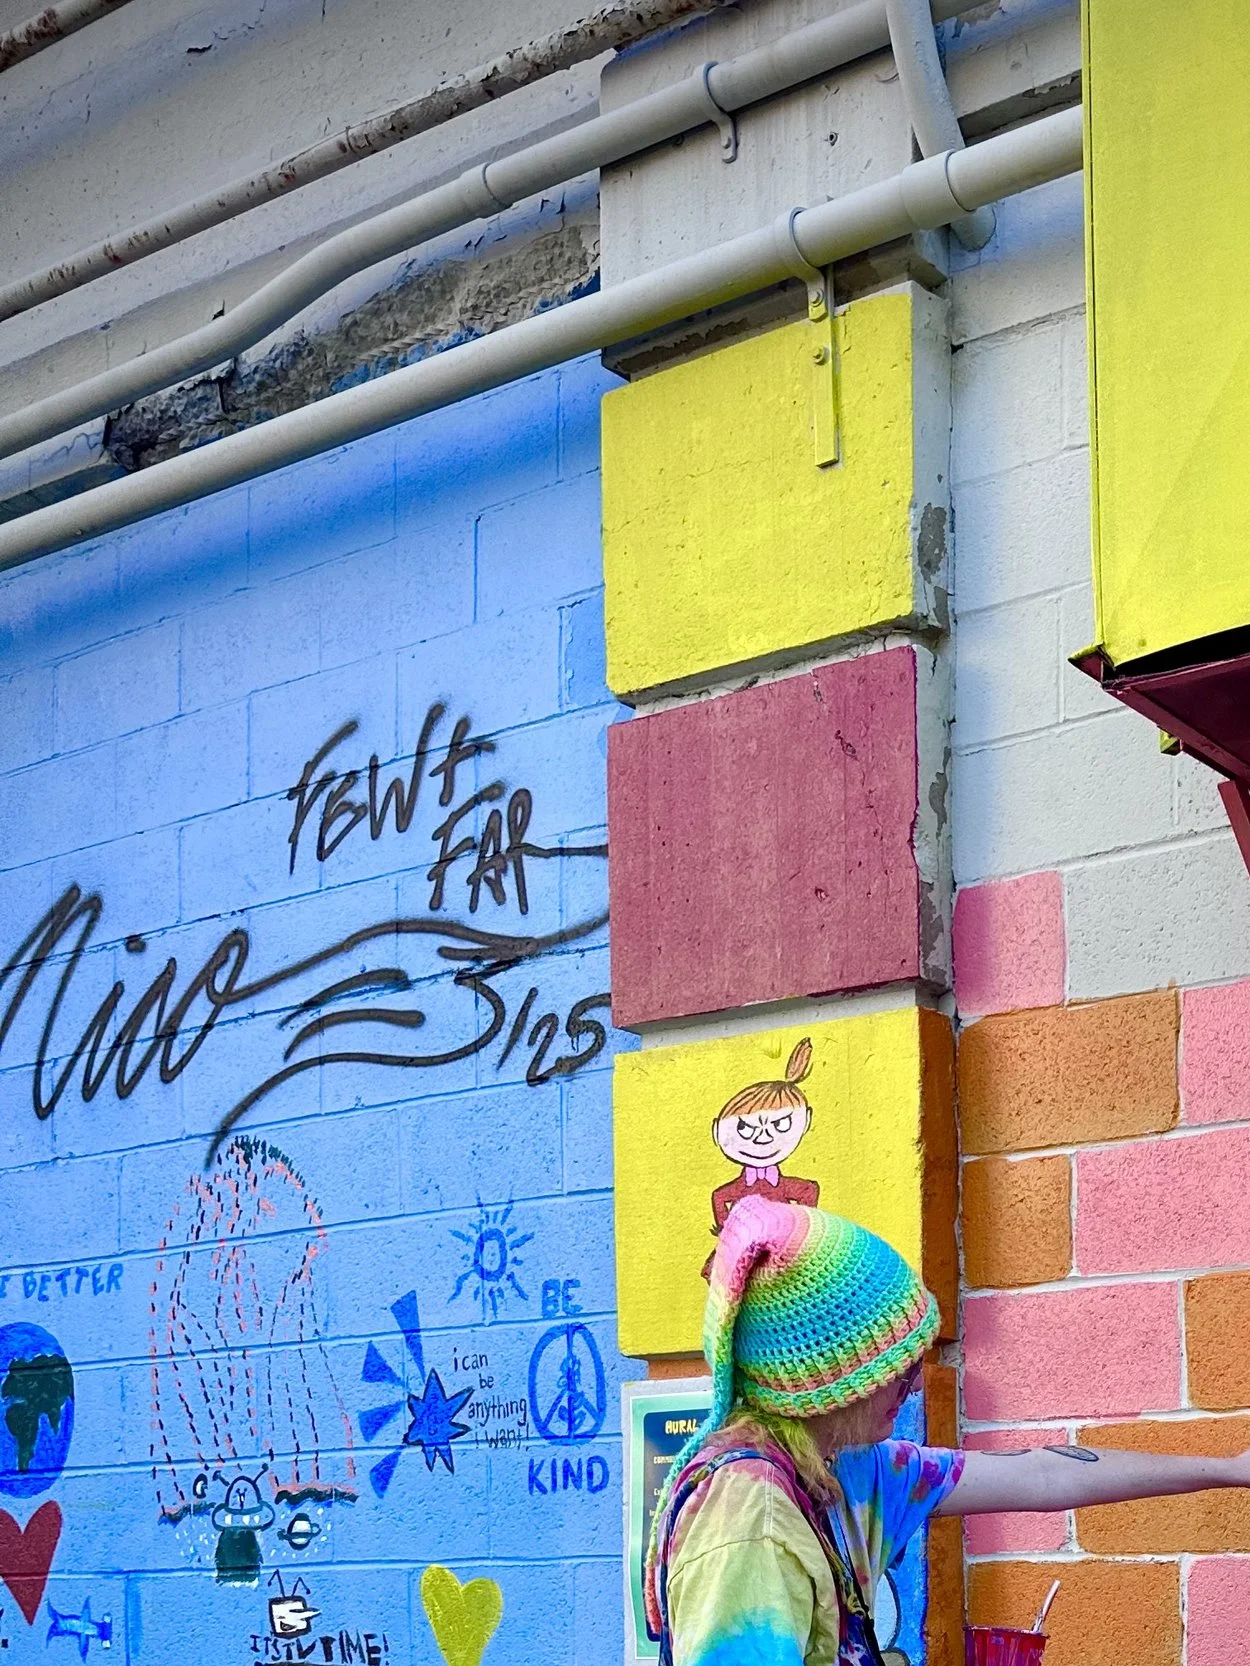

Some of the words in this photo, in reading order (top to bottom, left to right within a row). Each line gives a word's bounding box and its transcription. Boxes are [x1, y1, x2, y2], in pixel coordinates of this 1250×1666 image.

[22, 1262, 124, 1303] BETTER
[541, 1278, 584, 1319] BE
[461, 1353, 489, 1371] can
[478, 1372, 495, 1389] be
[467, 1394, 527, 1427] anything
[527, 1455, 611, 1496] KIND
